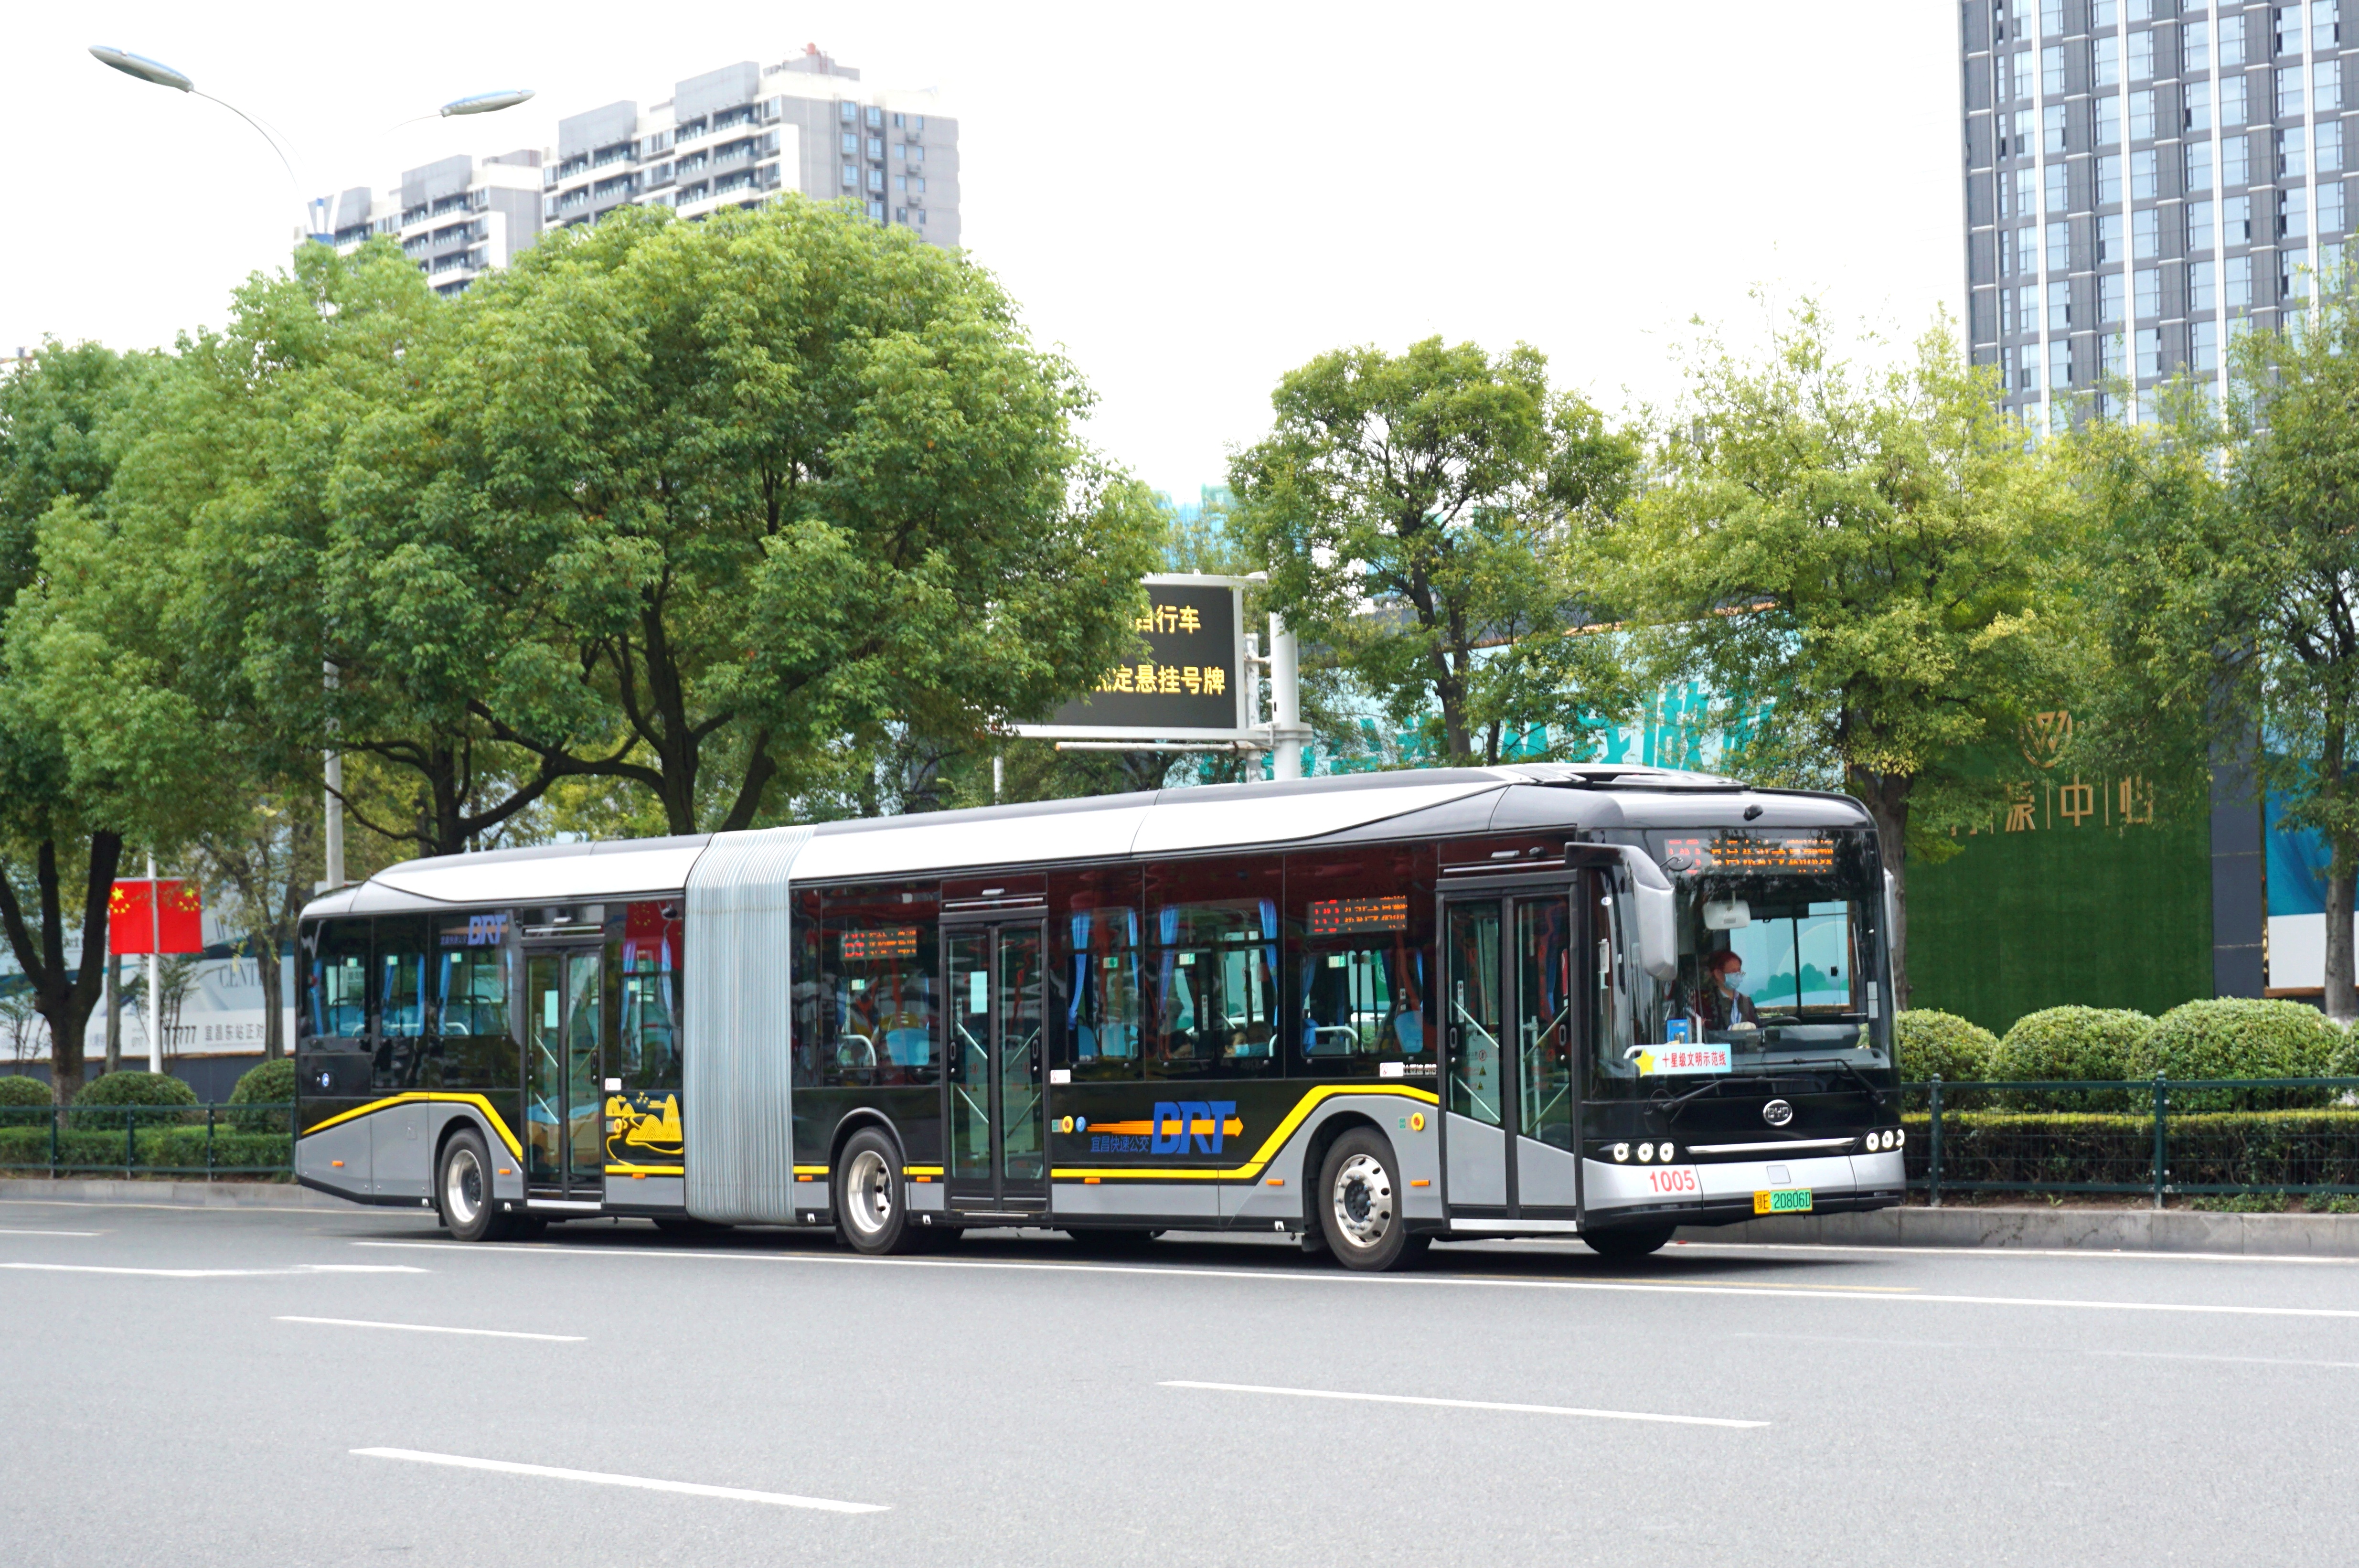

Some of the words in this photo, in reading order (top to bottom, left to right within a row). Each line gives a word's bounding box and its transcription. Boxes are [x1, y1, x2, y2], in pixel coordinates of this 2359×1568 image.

[467, 914, 507, 946] BRT
[220, 963, 264, 988] CENT
[1662, 1051, 1726, 1067] 十星级文明示范线
[1768, 1107, 1789, 1118] BYD
[1150, 1100, 1237, 1154] BRT
[1090, 1135, 1150, 1153] 宜昌快速公交
[1650, 1170, 1695, 1193] 1005
